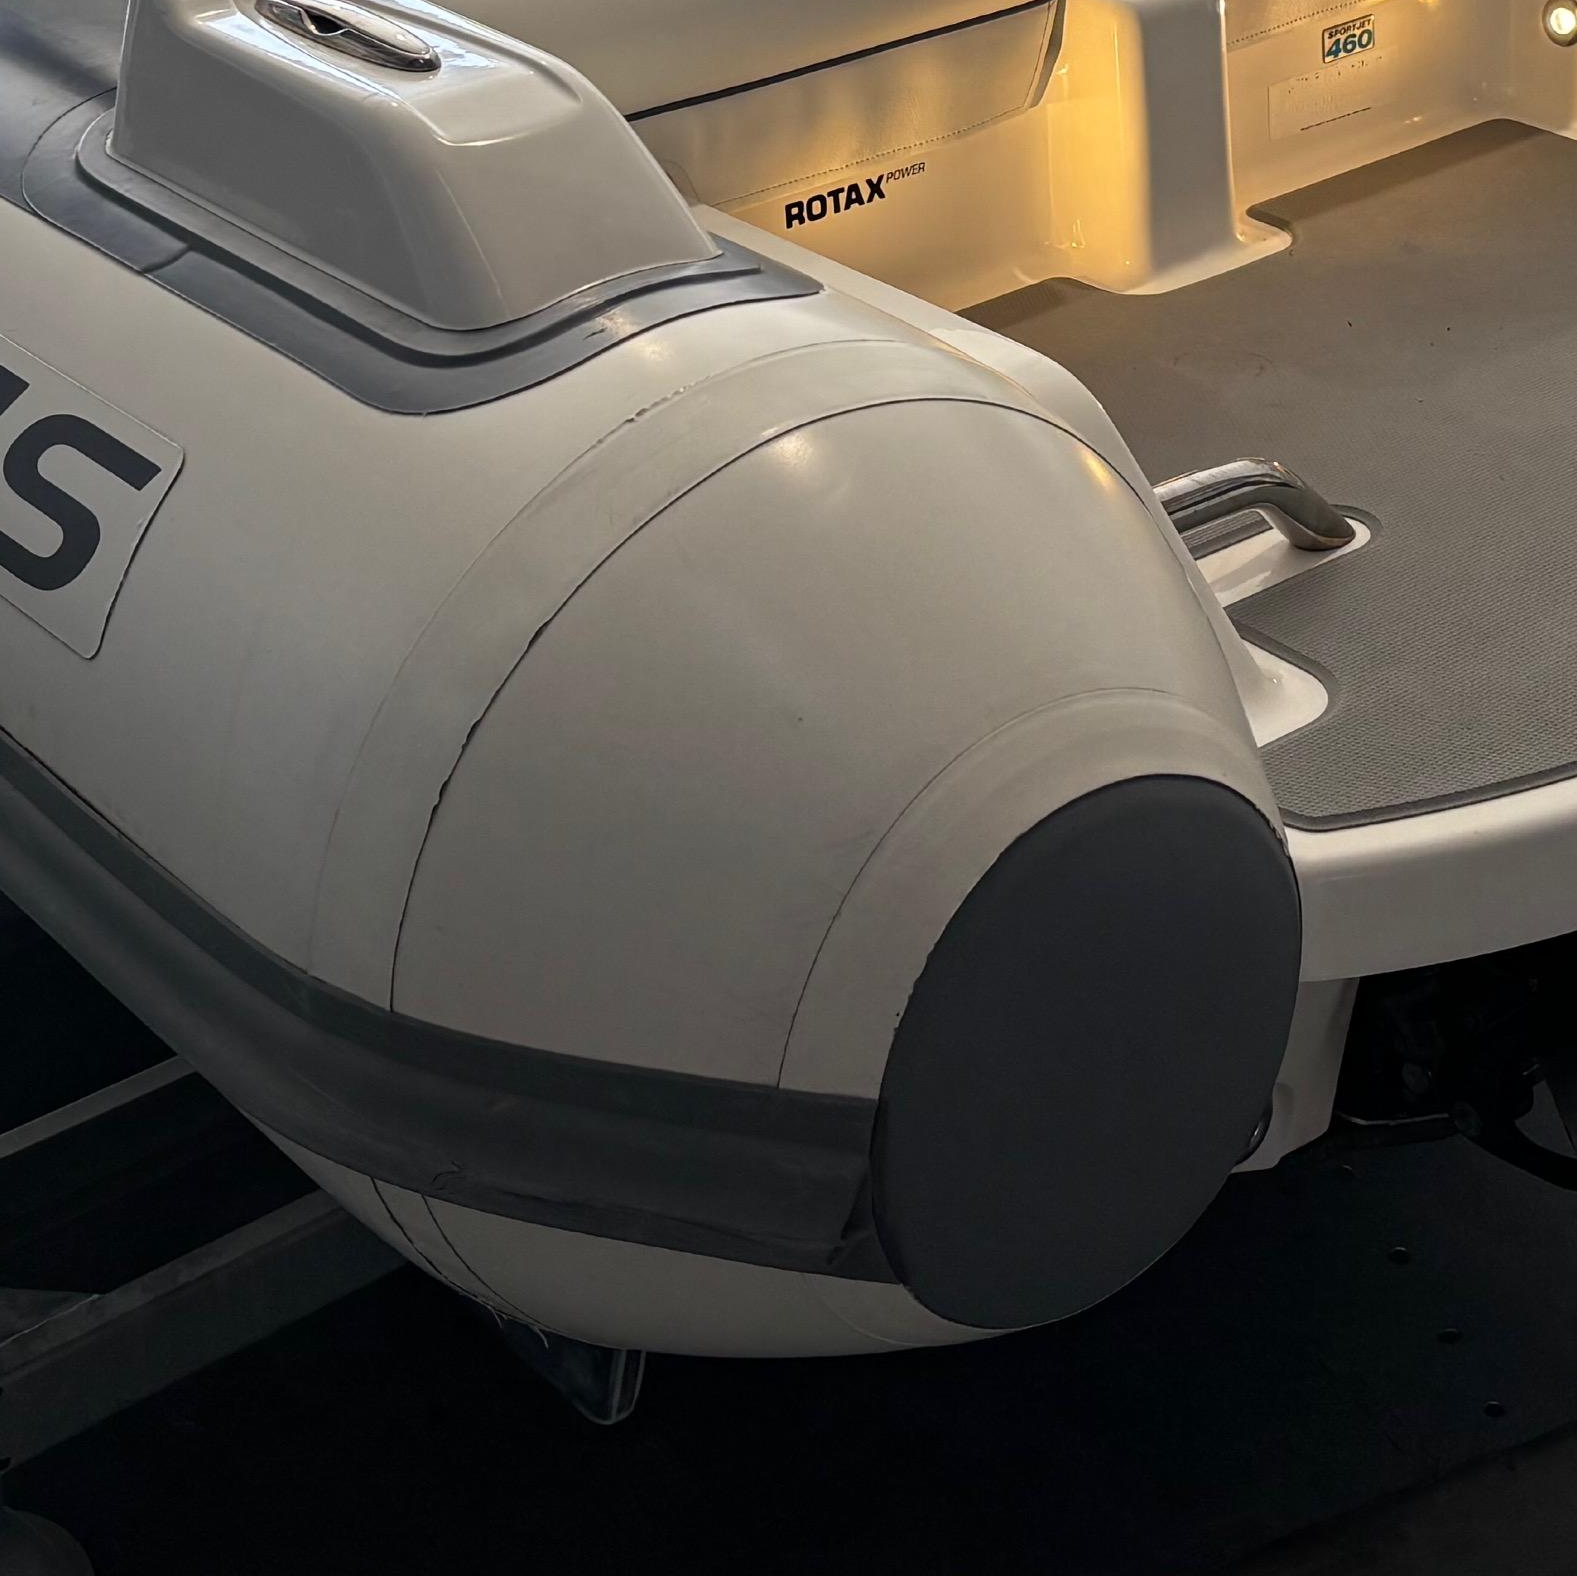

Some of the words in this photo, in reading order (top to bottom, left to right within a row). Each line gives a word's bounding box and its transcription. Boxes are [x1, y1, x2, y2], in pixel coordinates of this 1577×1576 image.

[1325, 28, 1373, 59] 460
[1327, 18, 1372, 40] SPORTJET
[784, 174, 886, 229] ROTAX
[885, 162, 926, 184] POWER
